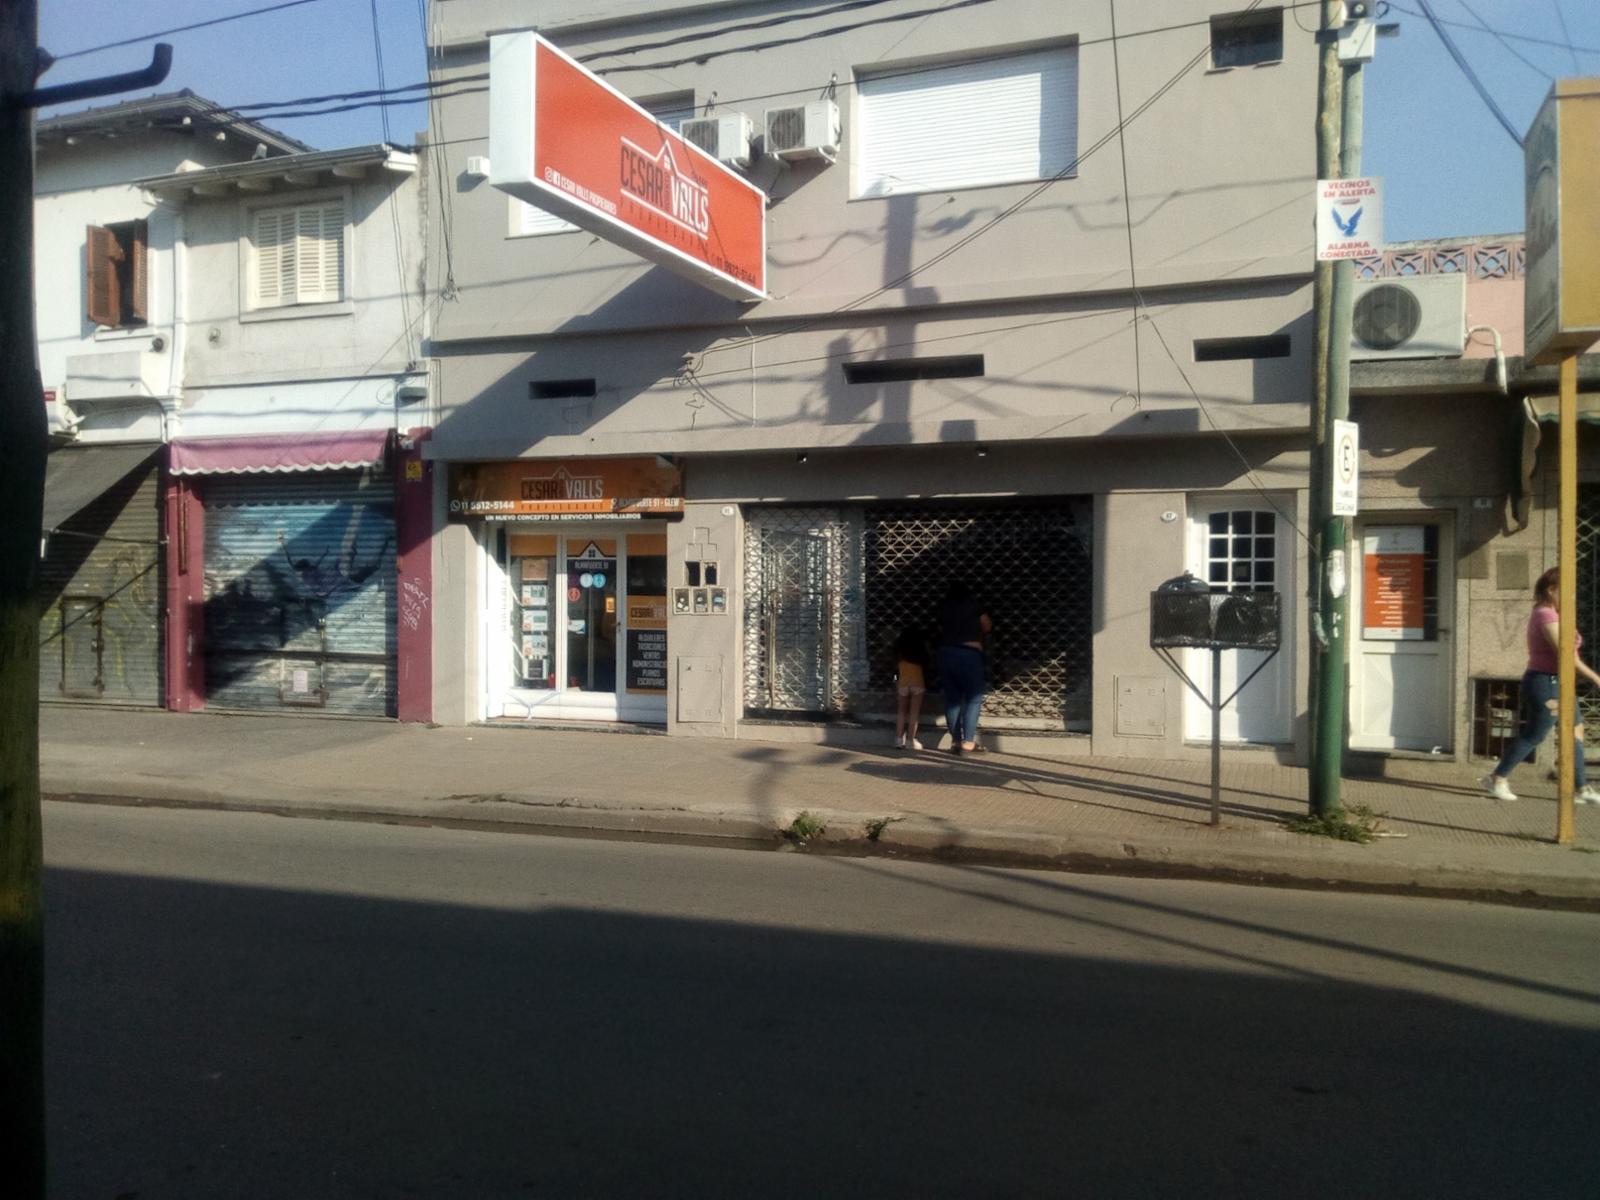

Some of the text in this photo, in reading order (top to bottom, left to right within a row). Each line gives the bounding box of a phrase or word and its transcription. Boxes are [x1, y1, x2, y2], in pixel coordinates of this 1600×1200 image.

[621, 145, 663, 208] CESAR
[671, 175, 708, 234] VALLS
[1327, 179, 1371, 190] VECINOS
[1338, 187, 1376, 198] ALERTA
[1327, 241, 1370, 250] ALARMA
[1320, 248, 1378, 259] CONECTADA
[521, 479, 605, 499] CESAR VALLS
[560, 513, 593, 521] SERVICIOS
